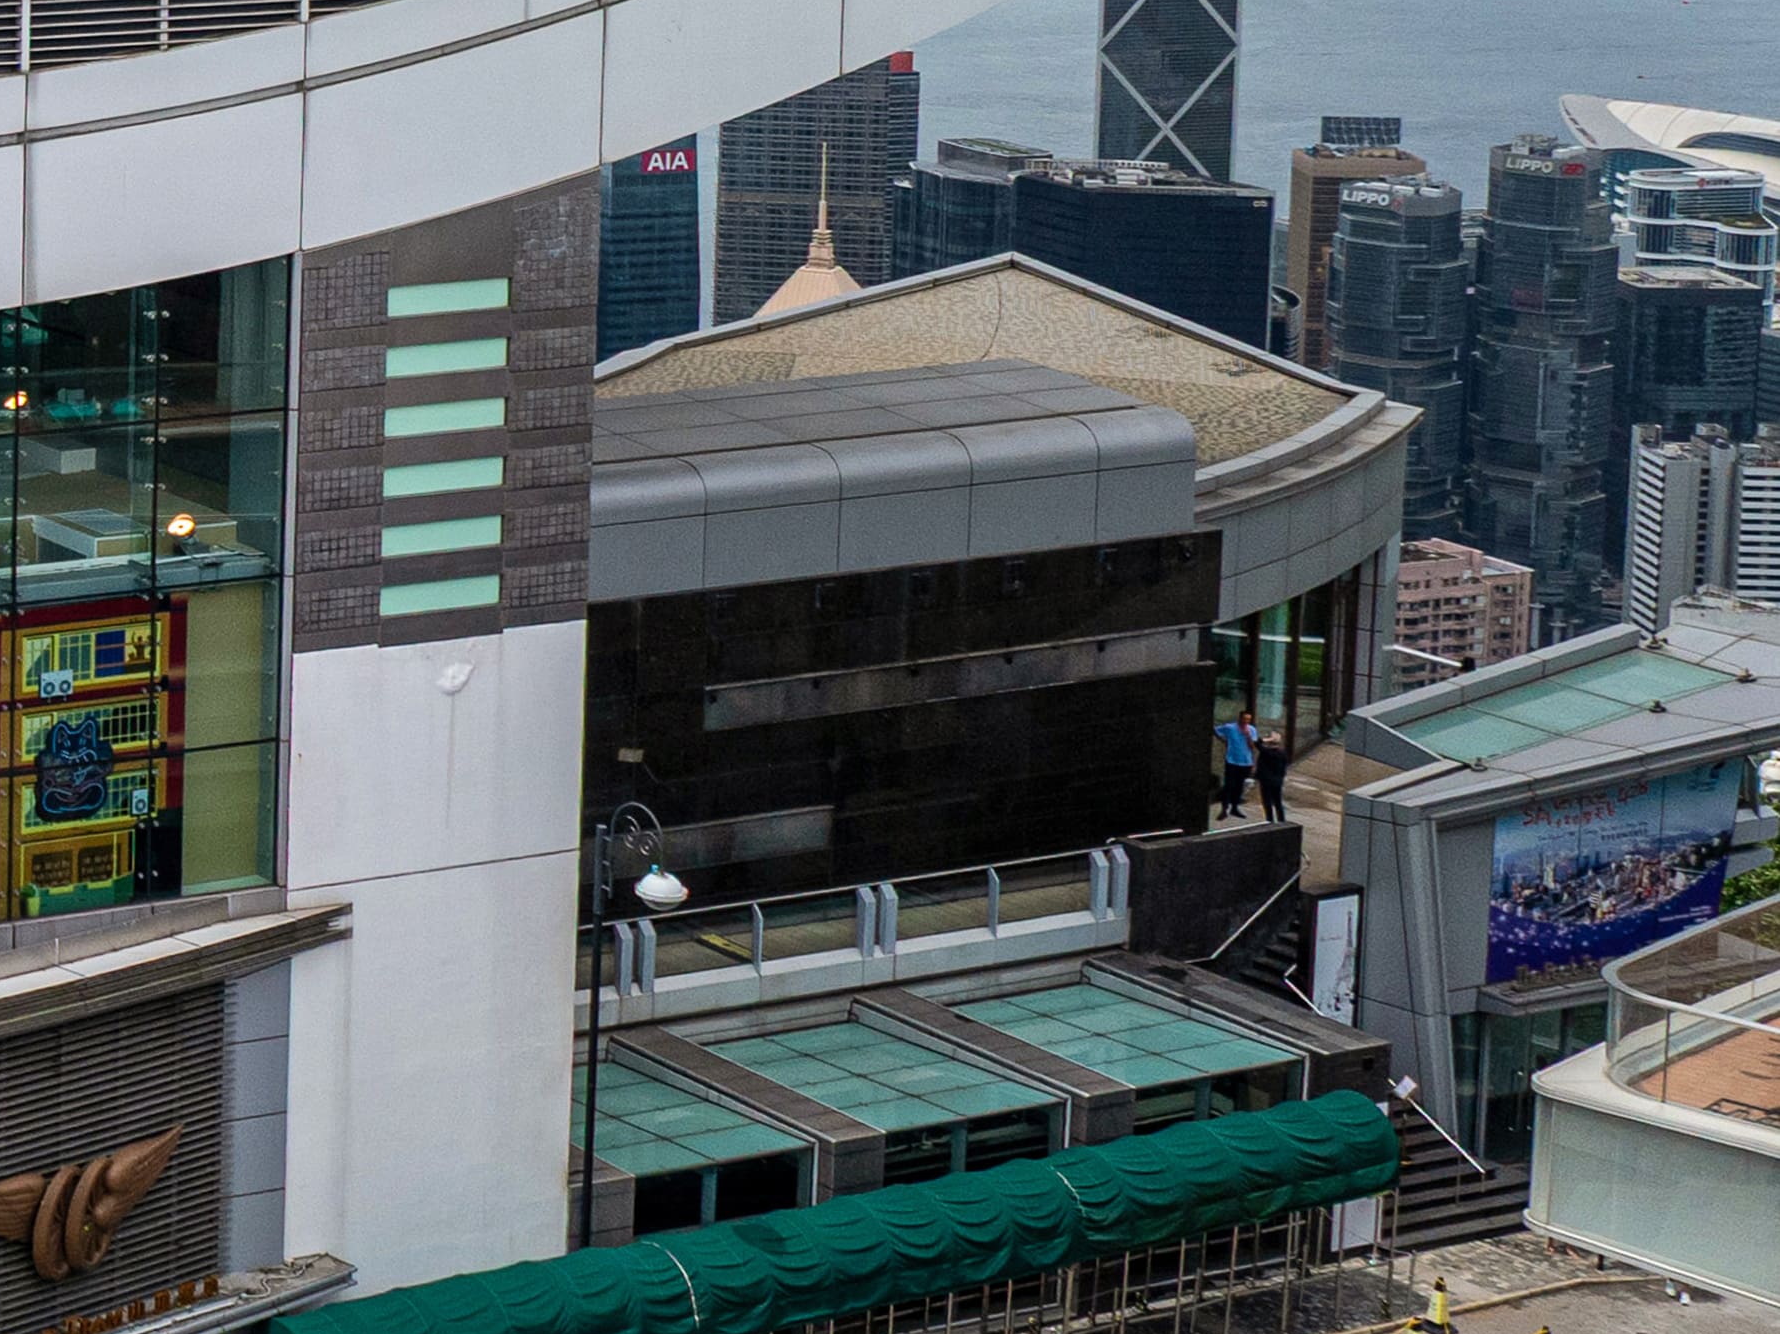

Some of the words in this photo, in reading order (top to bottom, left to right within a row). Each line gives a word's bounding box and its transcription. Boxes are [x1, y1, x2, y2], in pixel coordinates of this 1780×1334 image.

[647, 151, 689, 171] AIA
[1505, 155, 1553, 173] LIPPO
[1342, 189, 1389, 206] LIPPO
